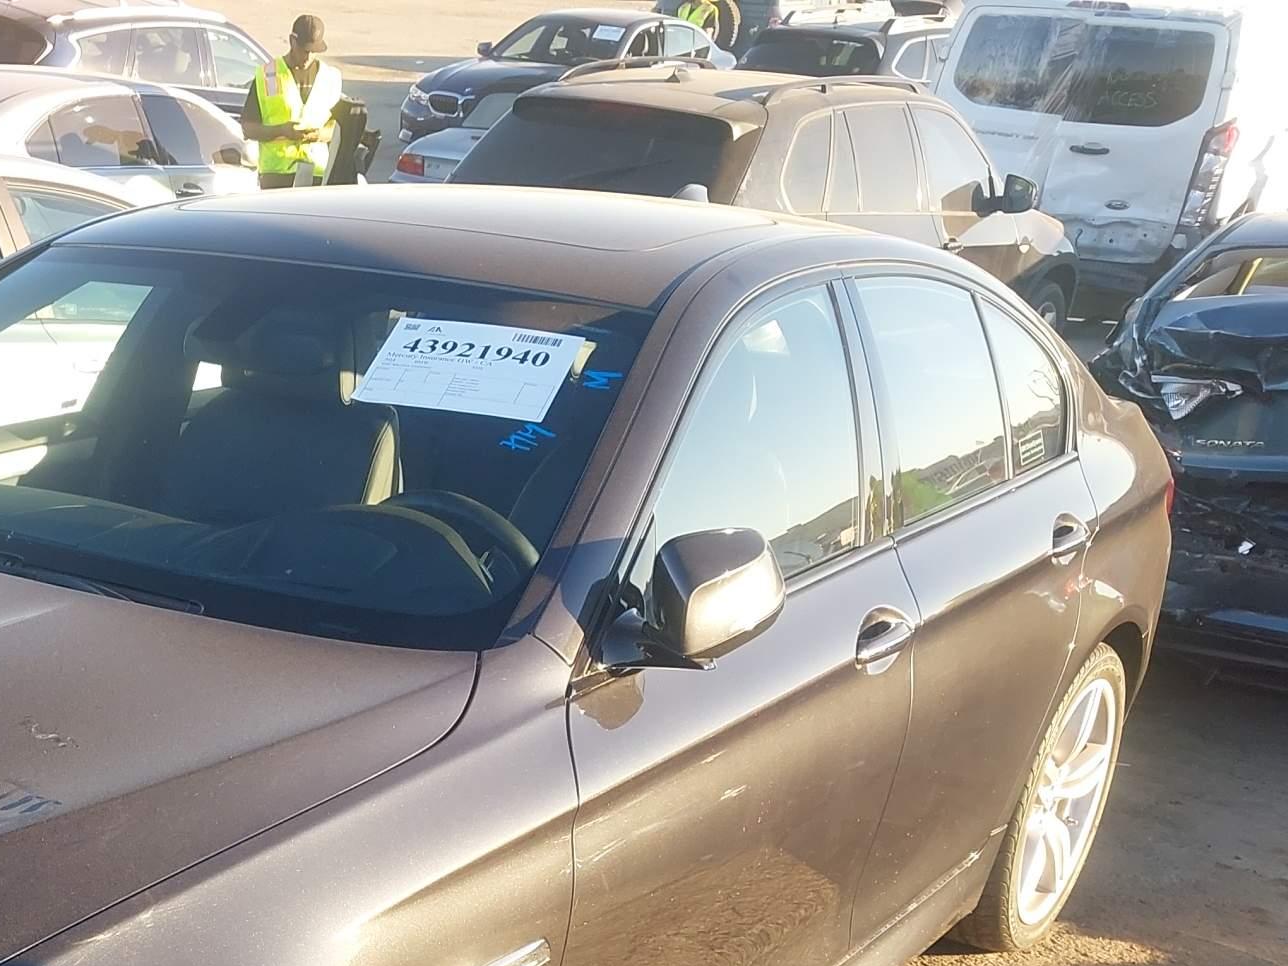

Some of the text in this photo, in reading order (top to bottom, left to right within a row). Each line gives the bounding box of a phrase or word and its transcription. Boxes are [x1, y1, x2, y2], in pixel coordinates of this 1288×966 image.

[403, 337, 551, 368] 43921940
[419, 354, 456, 363] Insurance
[1196, 439, 1265, 449] SONATA
